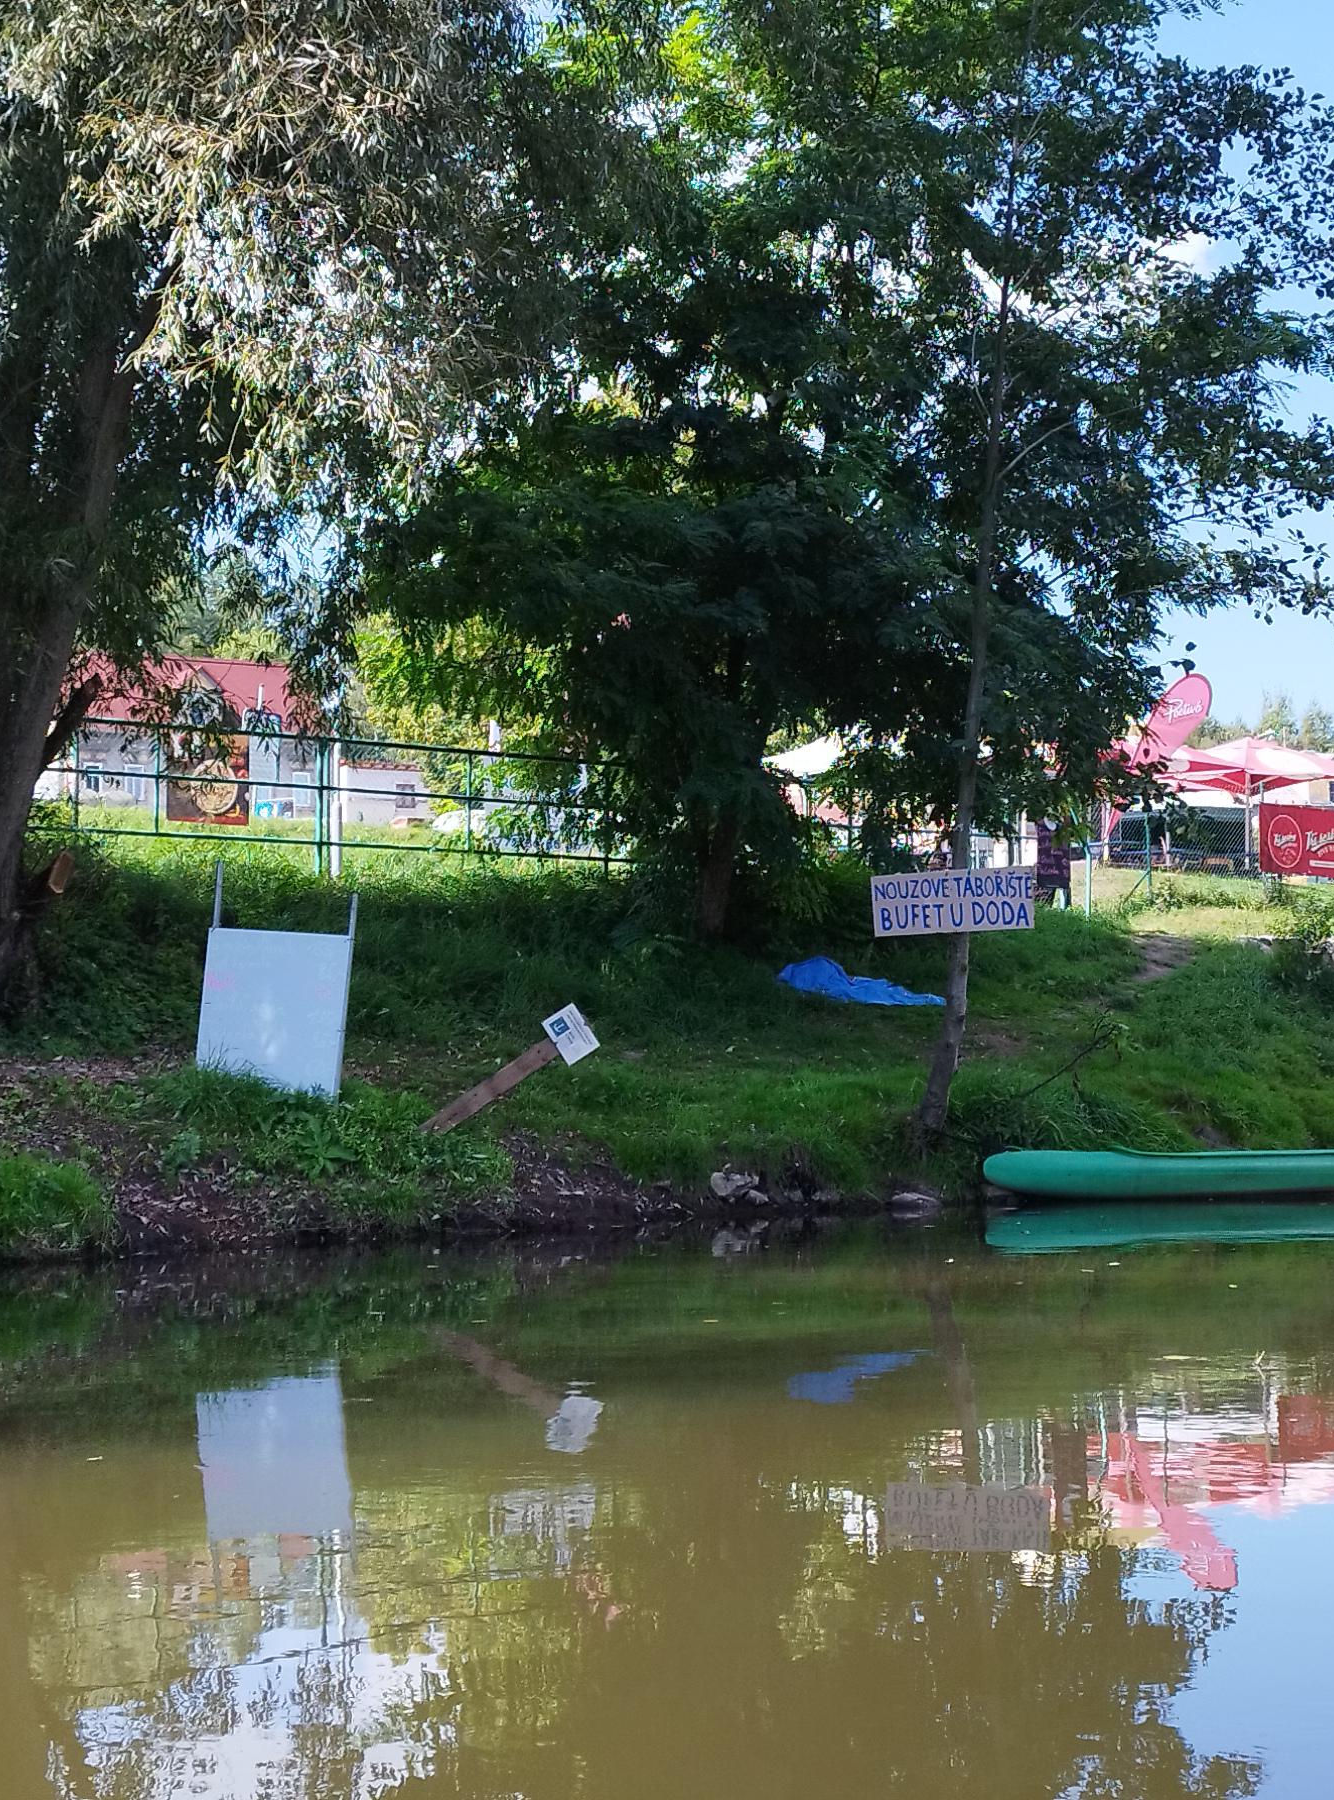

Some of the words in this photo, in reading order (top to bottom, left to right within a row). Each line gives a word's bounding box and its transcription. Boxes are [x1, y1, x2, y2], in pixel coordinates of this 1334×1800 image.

[952, 869, 1034, 899] TÁBOŘIŠTĚ
[879, 903, 945, 931] BUFET
[949, 902, 964, 927] U
[971, 900, 1030, 927] DODA
